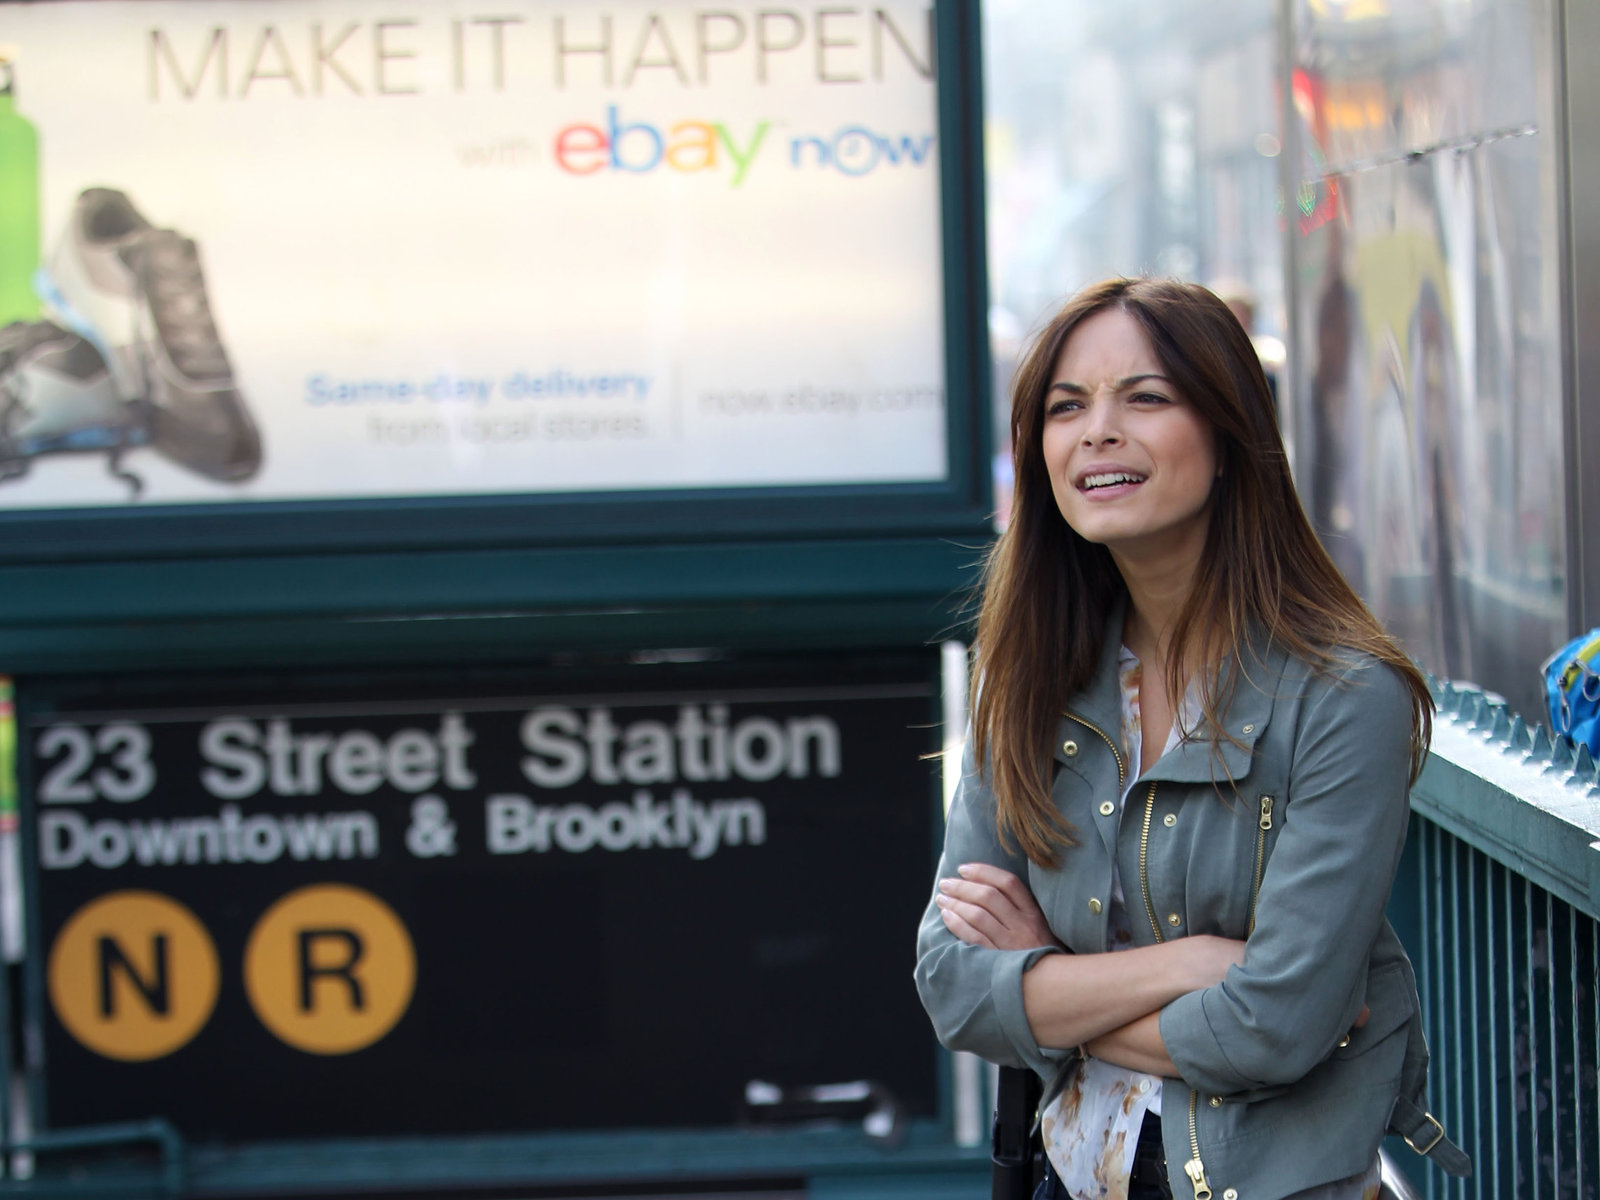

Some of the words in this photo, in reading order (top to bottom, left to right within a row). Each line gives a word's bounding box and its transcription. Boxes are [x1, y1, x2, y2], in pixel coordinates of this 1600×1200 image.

[144, 19, 421, 101] MAKE
[450, 16, 525, 92] IT
[553, 7, 937, 91] HAPPEN
[455, 133, 541, 168] with
[553, 104, 771, 187] ebay
[790, 124, 936, 177] now
[502, 370, 651, 403] delivery
[543, 409, 648, 440] stores
[37, 721, 157, 803] 23
[199, 713, 476, 799] Street
[519, 704, 842, 789] Station
[38, 806, 379, 869] Downtown
[405, 795, 458, 859] &
[485, 790, 766, 860] Brooklyn
[95, 930, 172, 1022] N
[293, 925, 370, 1014] R
